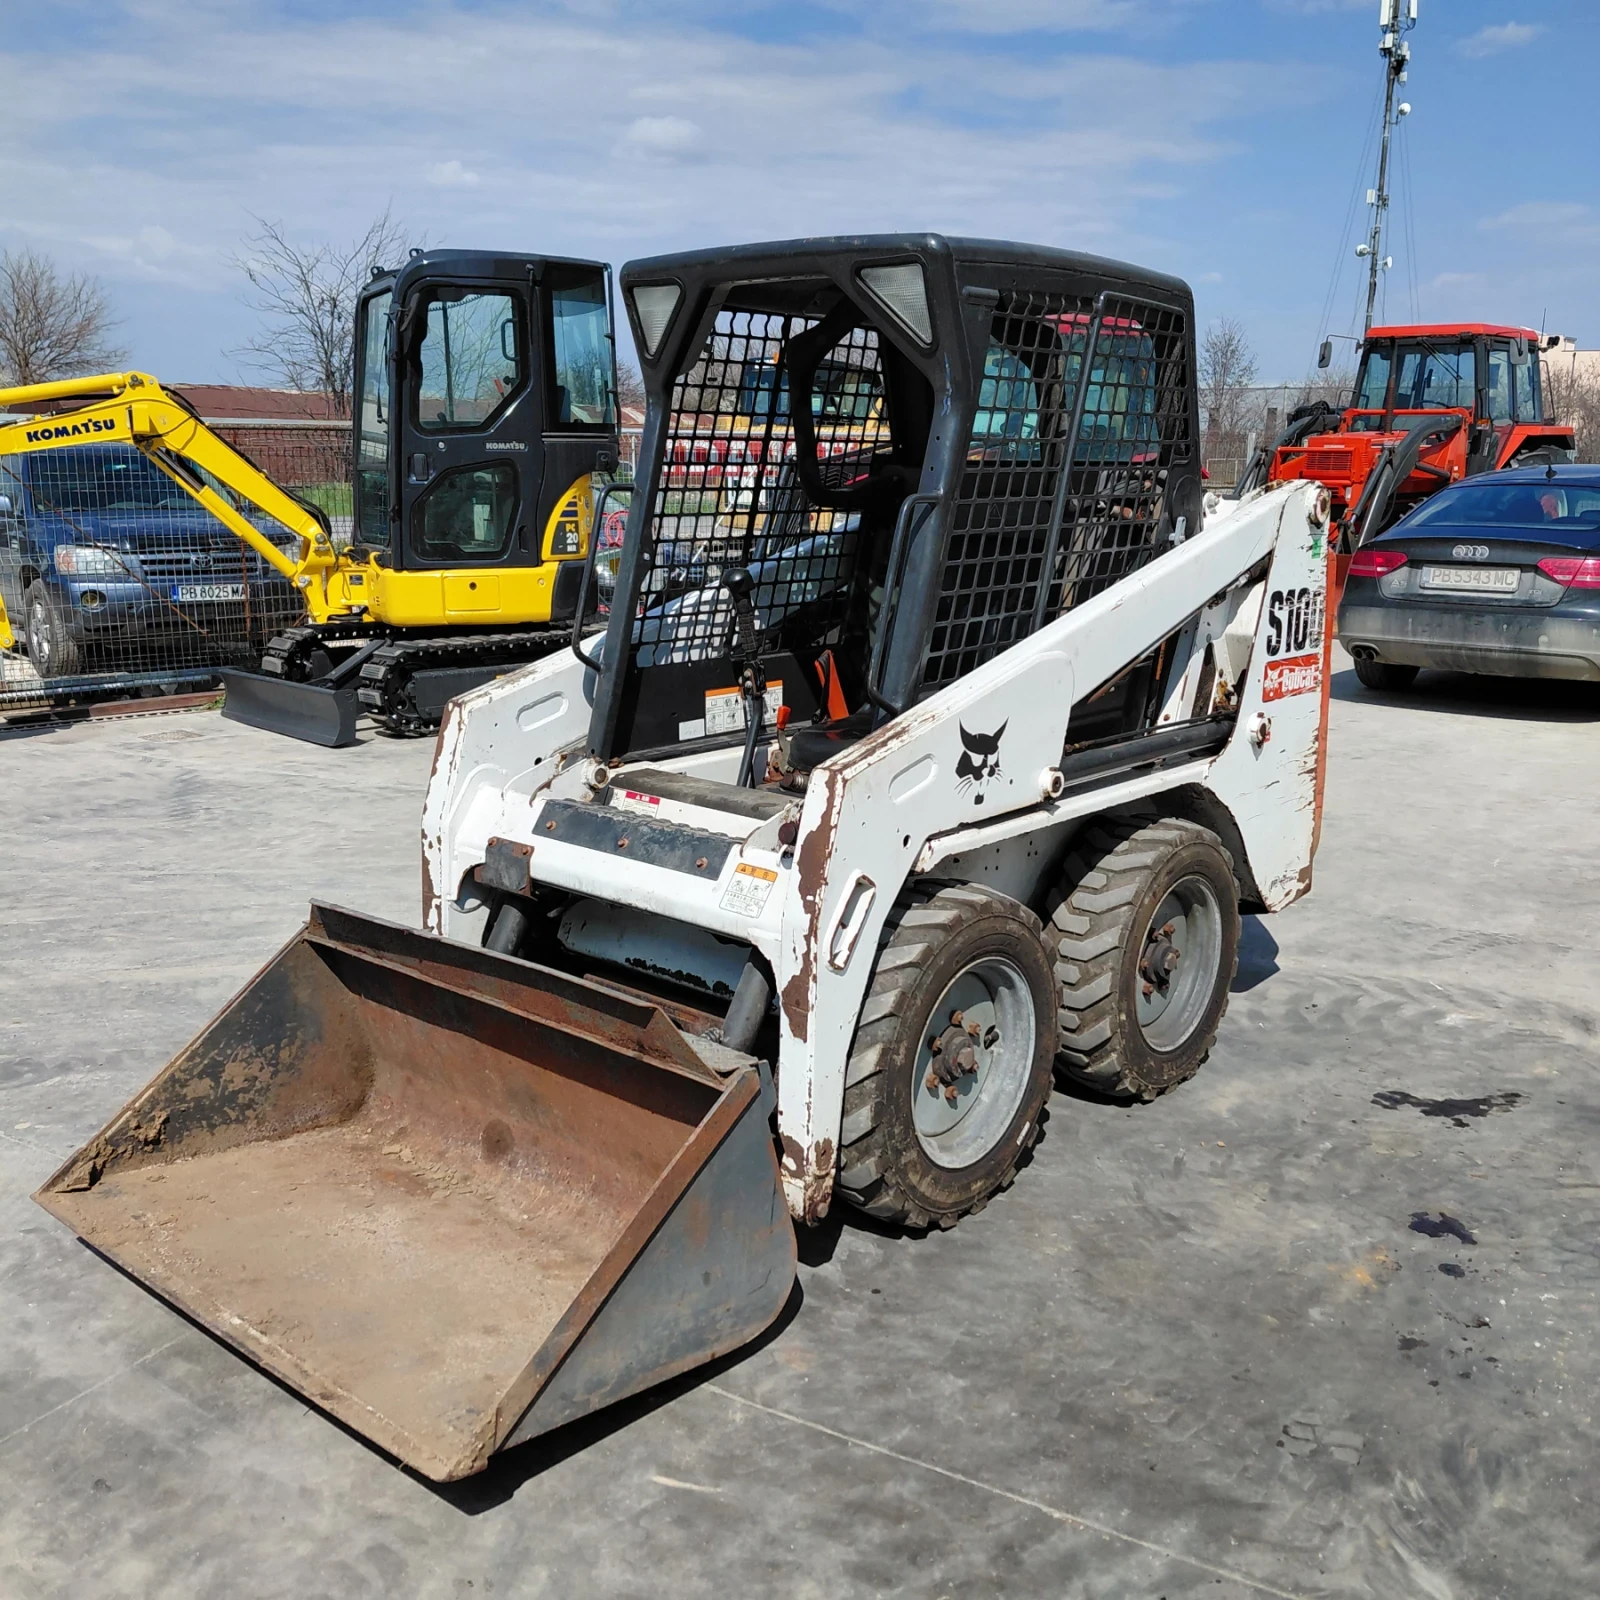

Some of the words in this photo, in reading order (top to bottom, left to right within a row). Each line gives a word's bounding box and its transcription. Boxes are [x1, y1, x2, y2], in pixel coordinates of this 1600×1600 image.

[26, 418, 115, 443] KOMATSU
[485, 441, 525, 450] KOMATSU
[565, 523, 576, 532] PC
[566, 532, 579, 544] 20
[1390, 579, 1407, 588] A5
[1432, 569, 1451, 583] PB
[1452, 571, 1491, 585] 5343
[1493, 571, 1515, 586] MC
[181, 587, 198, 599] PB
[200, 586, 230, 599] 8025
